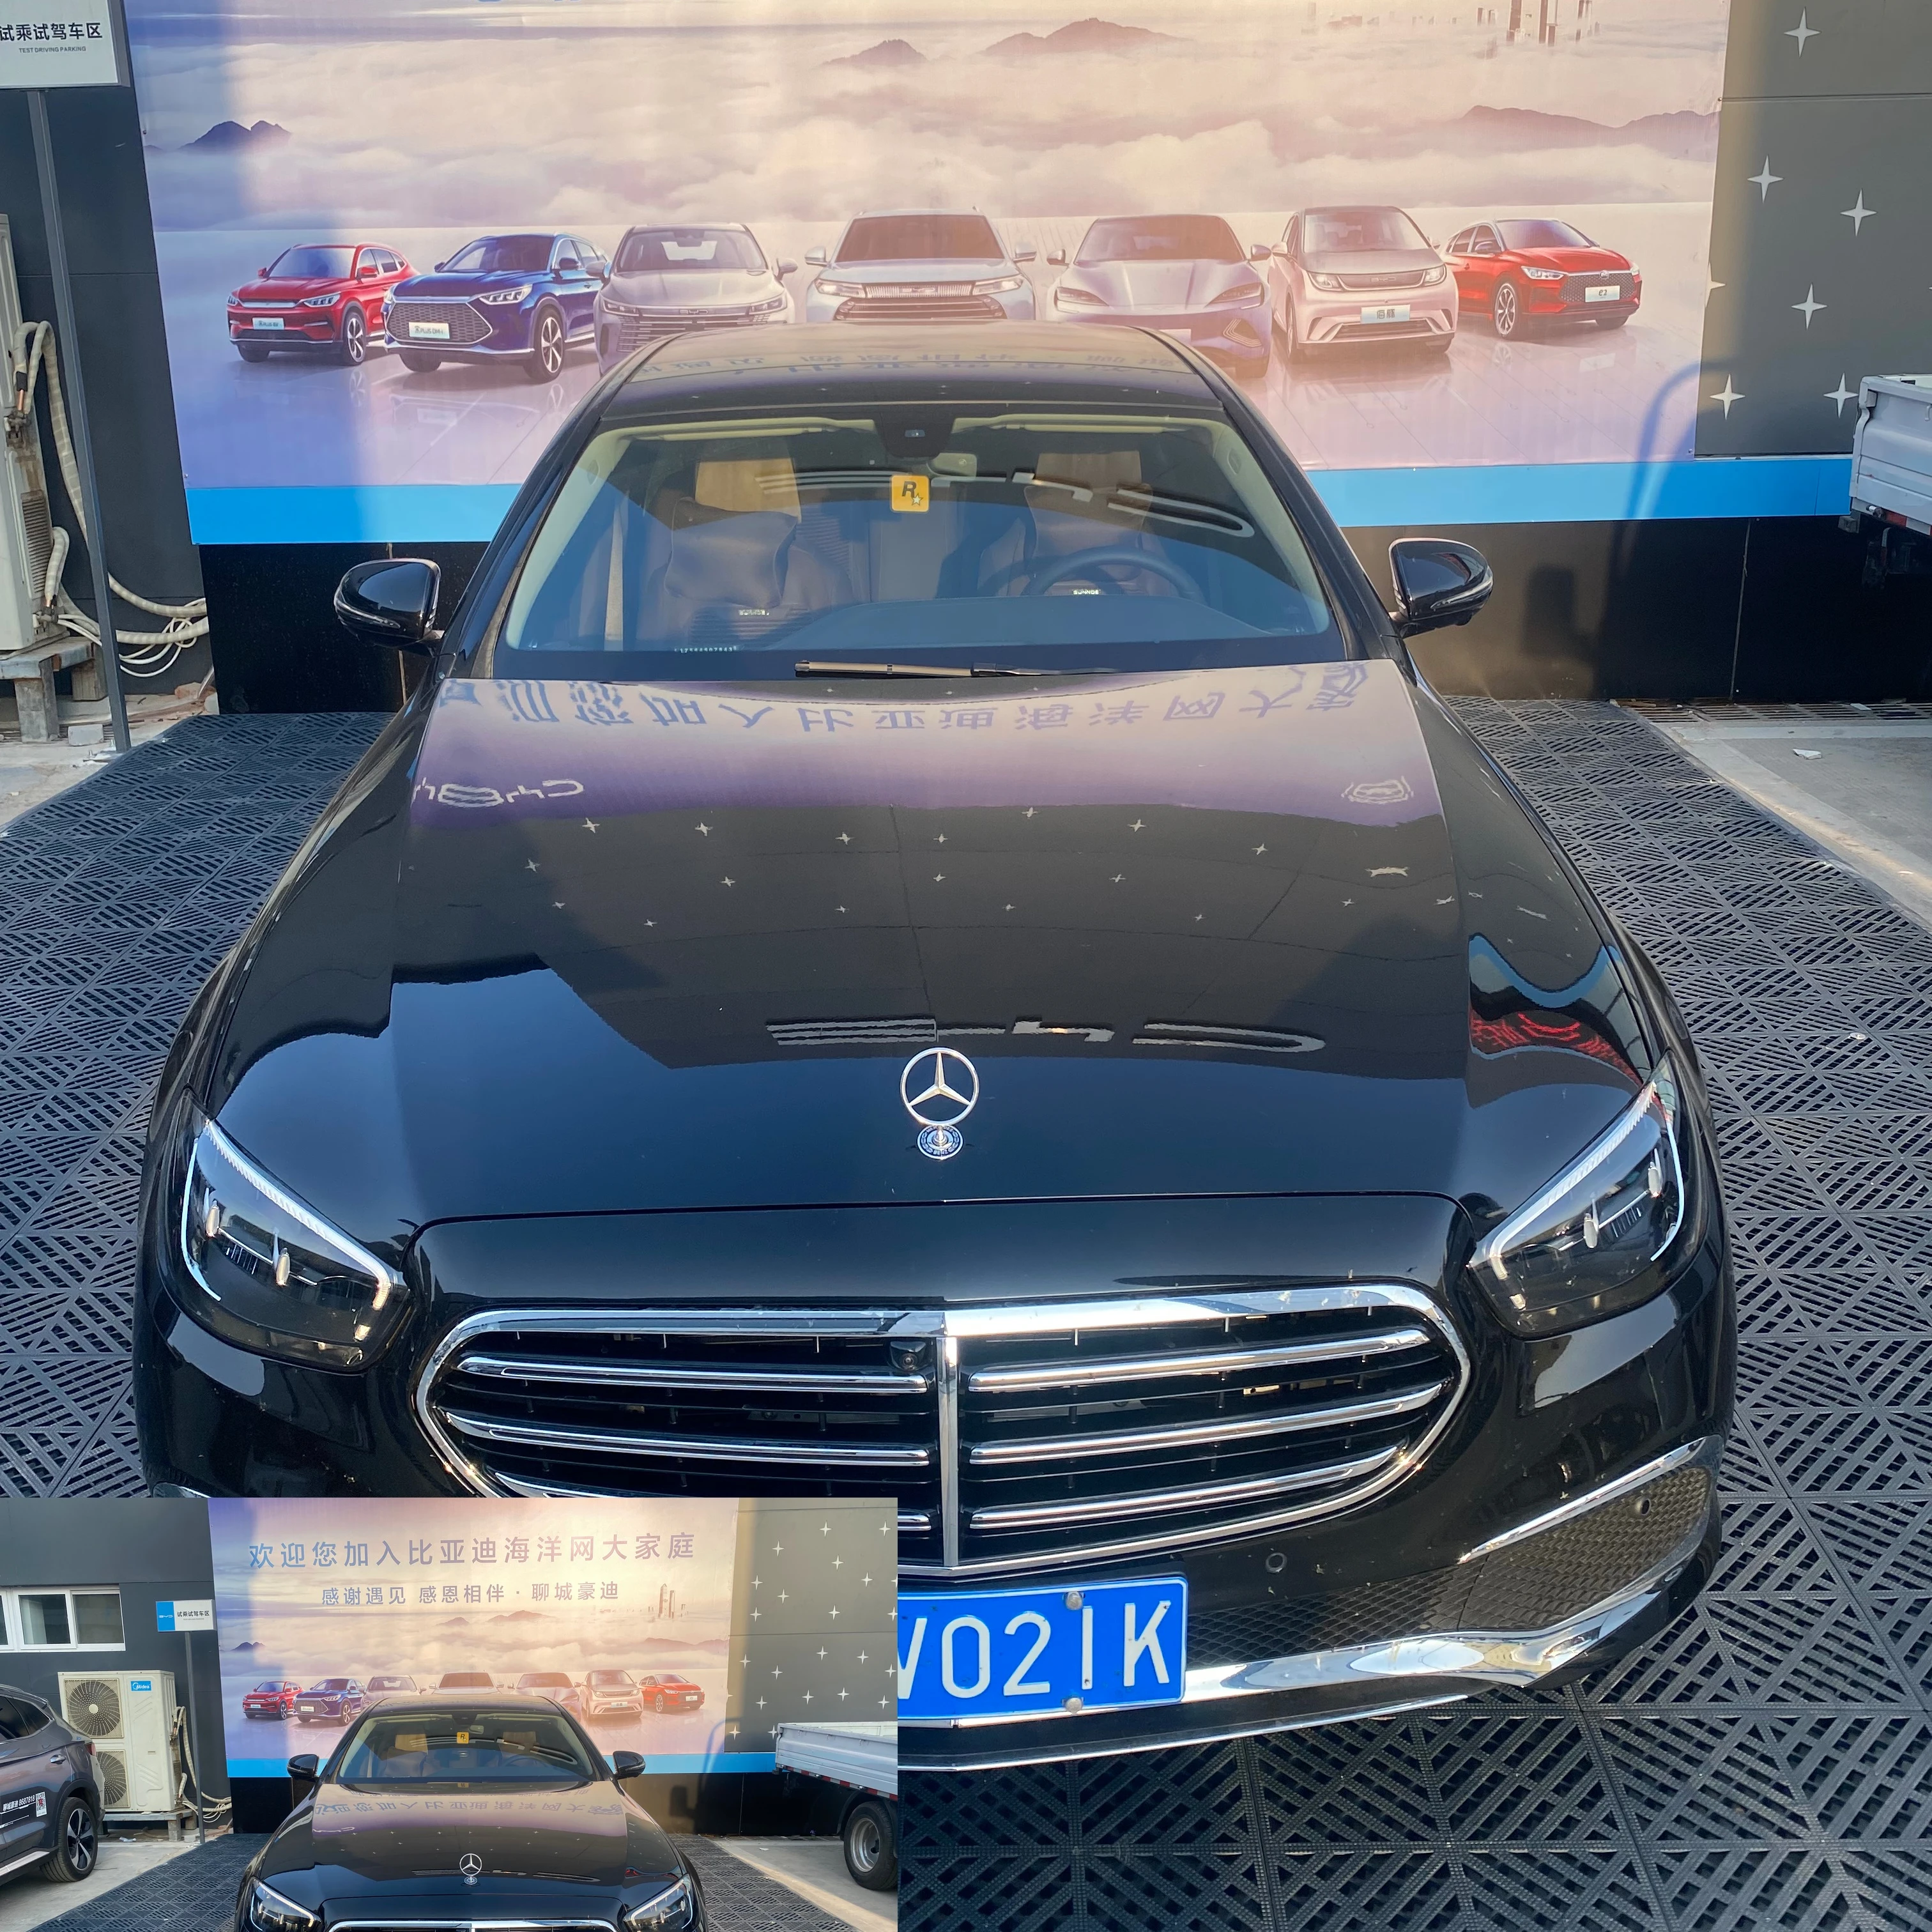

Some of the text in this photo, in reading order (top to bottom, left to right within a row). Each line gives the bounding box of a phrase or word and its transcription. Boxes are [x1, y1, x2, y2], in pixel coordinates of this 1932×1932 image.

[0, 22, 102, 41] 试乘试驾车区
[901, 481, 917, 498] R
[249, 1533, 695, 1570] 欢迎您加入比亚迪海洋网大家庭
[321, 1586, 407, 1606] 感谢遇见
